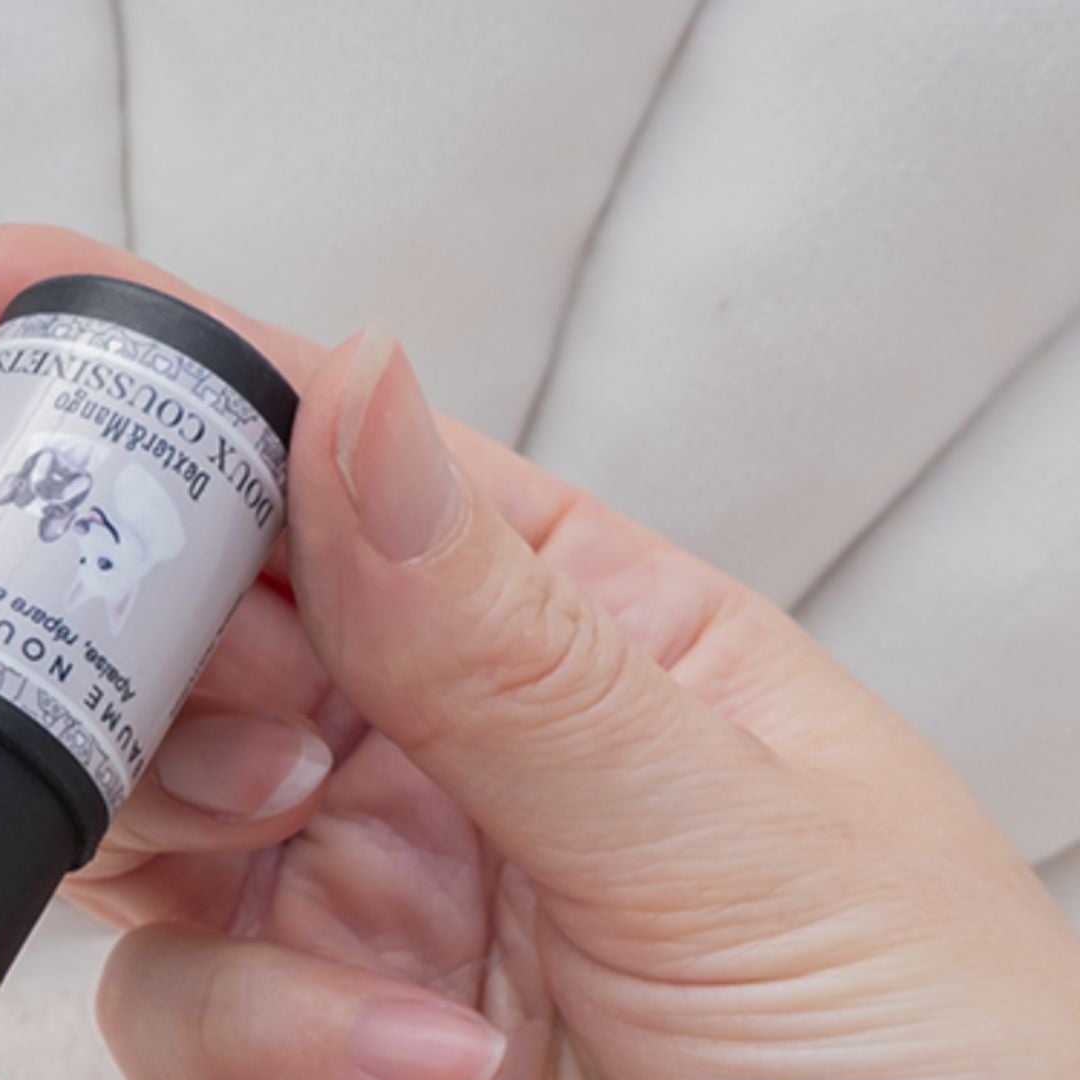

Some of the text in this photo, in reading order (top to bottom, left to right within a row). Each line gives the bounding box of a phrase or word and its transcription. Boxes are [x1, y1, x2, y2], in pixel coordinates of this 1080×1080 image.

[54, 387, 211, 502] Dexter&Mango
[209, 435, 275, 529] DOUX
[10, 597, 80, 646] répare
[84, 640, 137, 703] Apaise,
